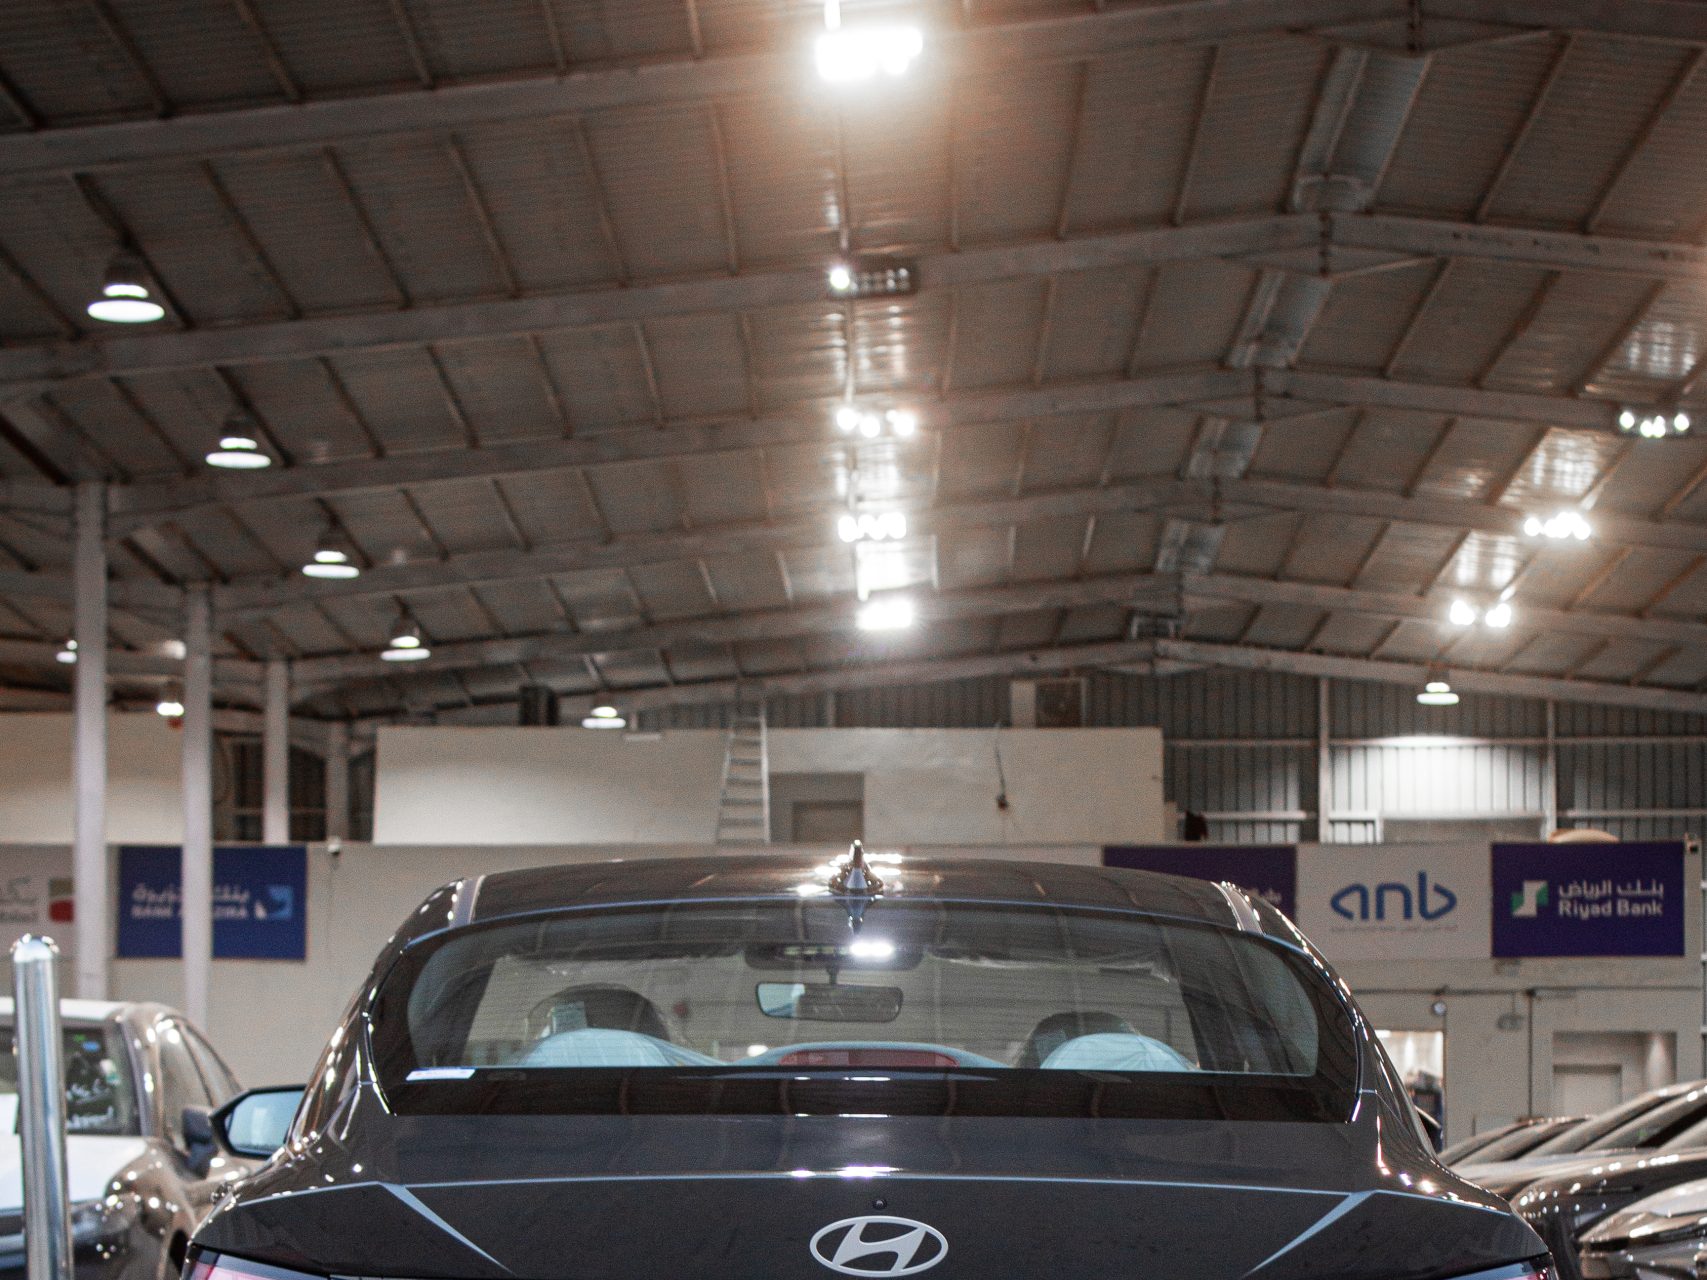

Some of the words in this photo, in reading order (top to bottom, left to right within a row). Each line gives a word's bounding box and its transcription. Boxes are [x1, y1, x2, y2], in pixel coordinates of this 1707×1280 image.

[1330, 870, 1458, 920] anb
[1558, 879, 1612, 899] الرياض
[1558, 899, 1612, 920] Riyad
[1617, 899, 1663, 916] Bank
